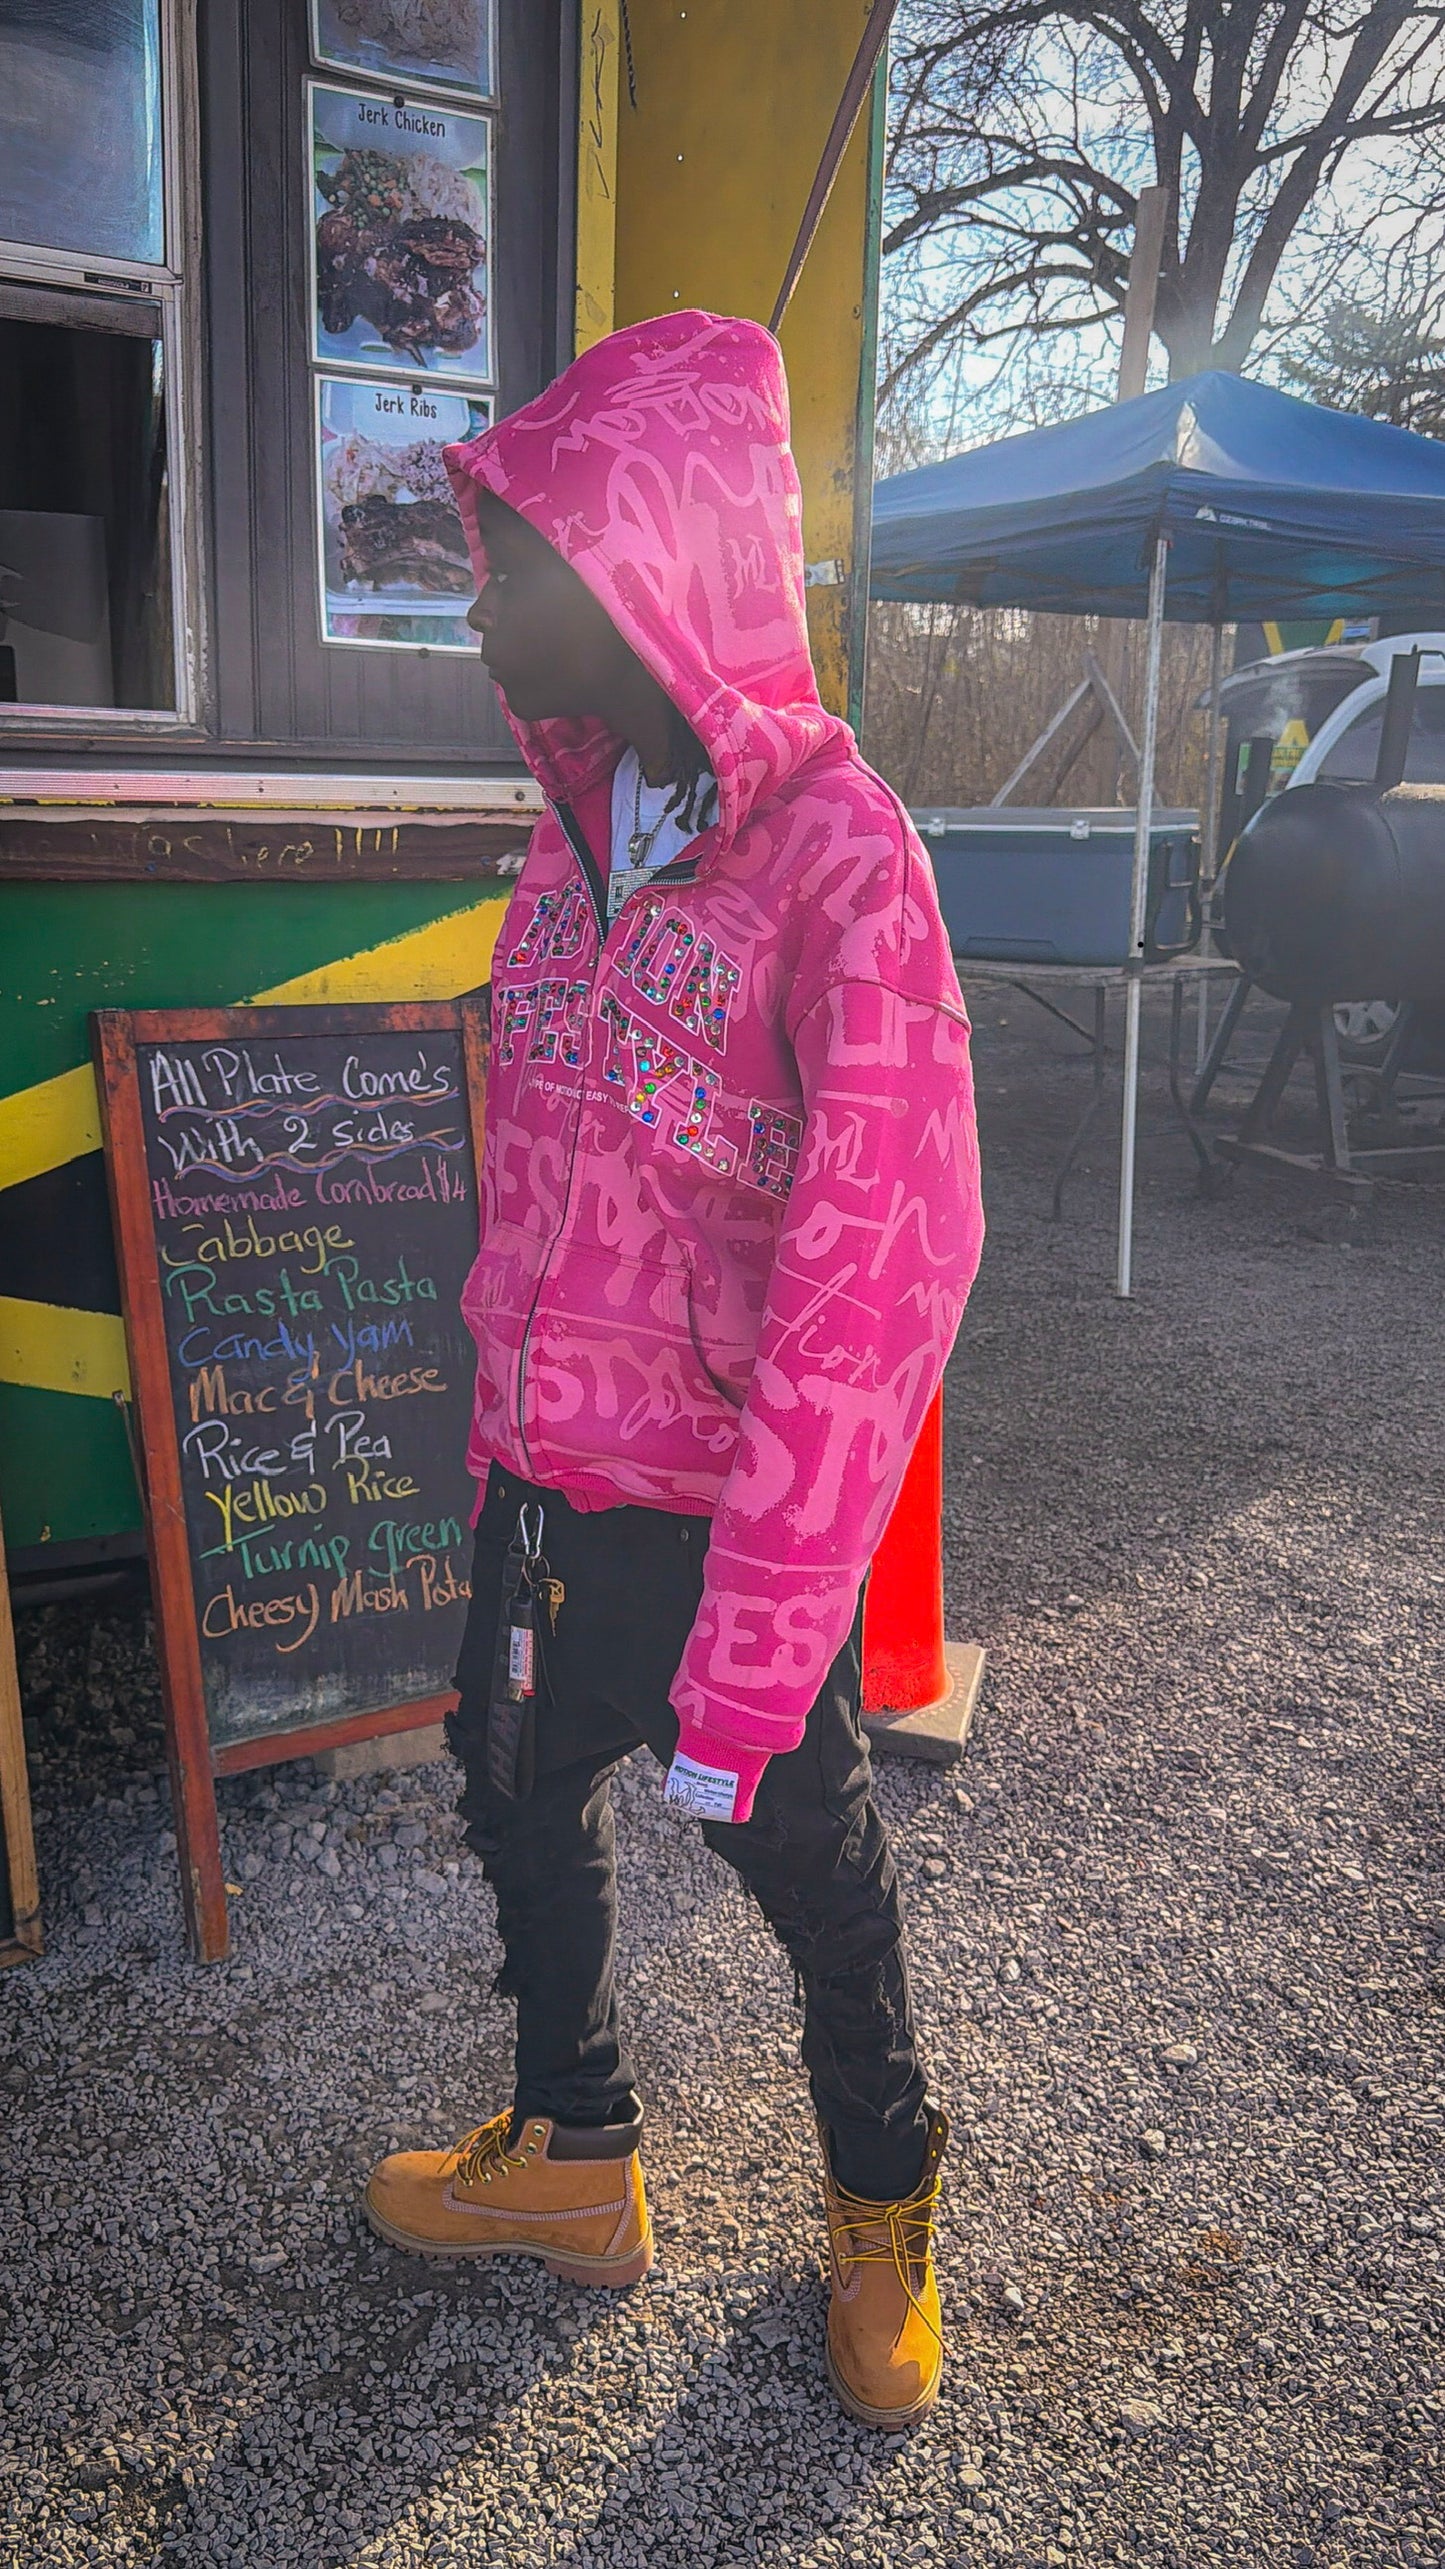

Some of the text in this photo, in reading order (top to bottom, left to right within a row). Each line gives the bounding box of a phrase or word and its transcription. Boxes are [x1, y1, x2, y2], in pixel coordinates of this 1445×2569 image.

[358, 103, 446, 138] Jerk Chicken
[375, 392, 438, 419] Jerk Ribs
[149, 1047, 452, 1114] All Plate Come's
[158, 1115, 264, 1171] With
[283, 1114, 317, 1154] 2
[153, 1173, 308, 1219] Homemade
[315, 1156, 437, 1206] Cornbread
[161, 1215, 356, 1274] Cabbage
[165, 1255, 437, 1323] Rasta Pasta
[178, 1320, 315, 1382] Candy
[189, 1364, 277, 1422] Mac
[328, 1359, 449, 1407] Cheese
[183, 1410, 393, 1480] Rice & Pea
[332, 1455, 421, 1504] Rice
[199, 1523, 350, 1579] Turnip
[202, 1583, 319, 1653] Cheesy
[330, 1570, 409, 1623] Mash
